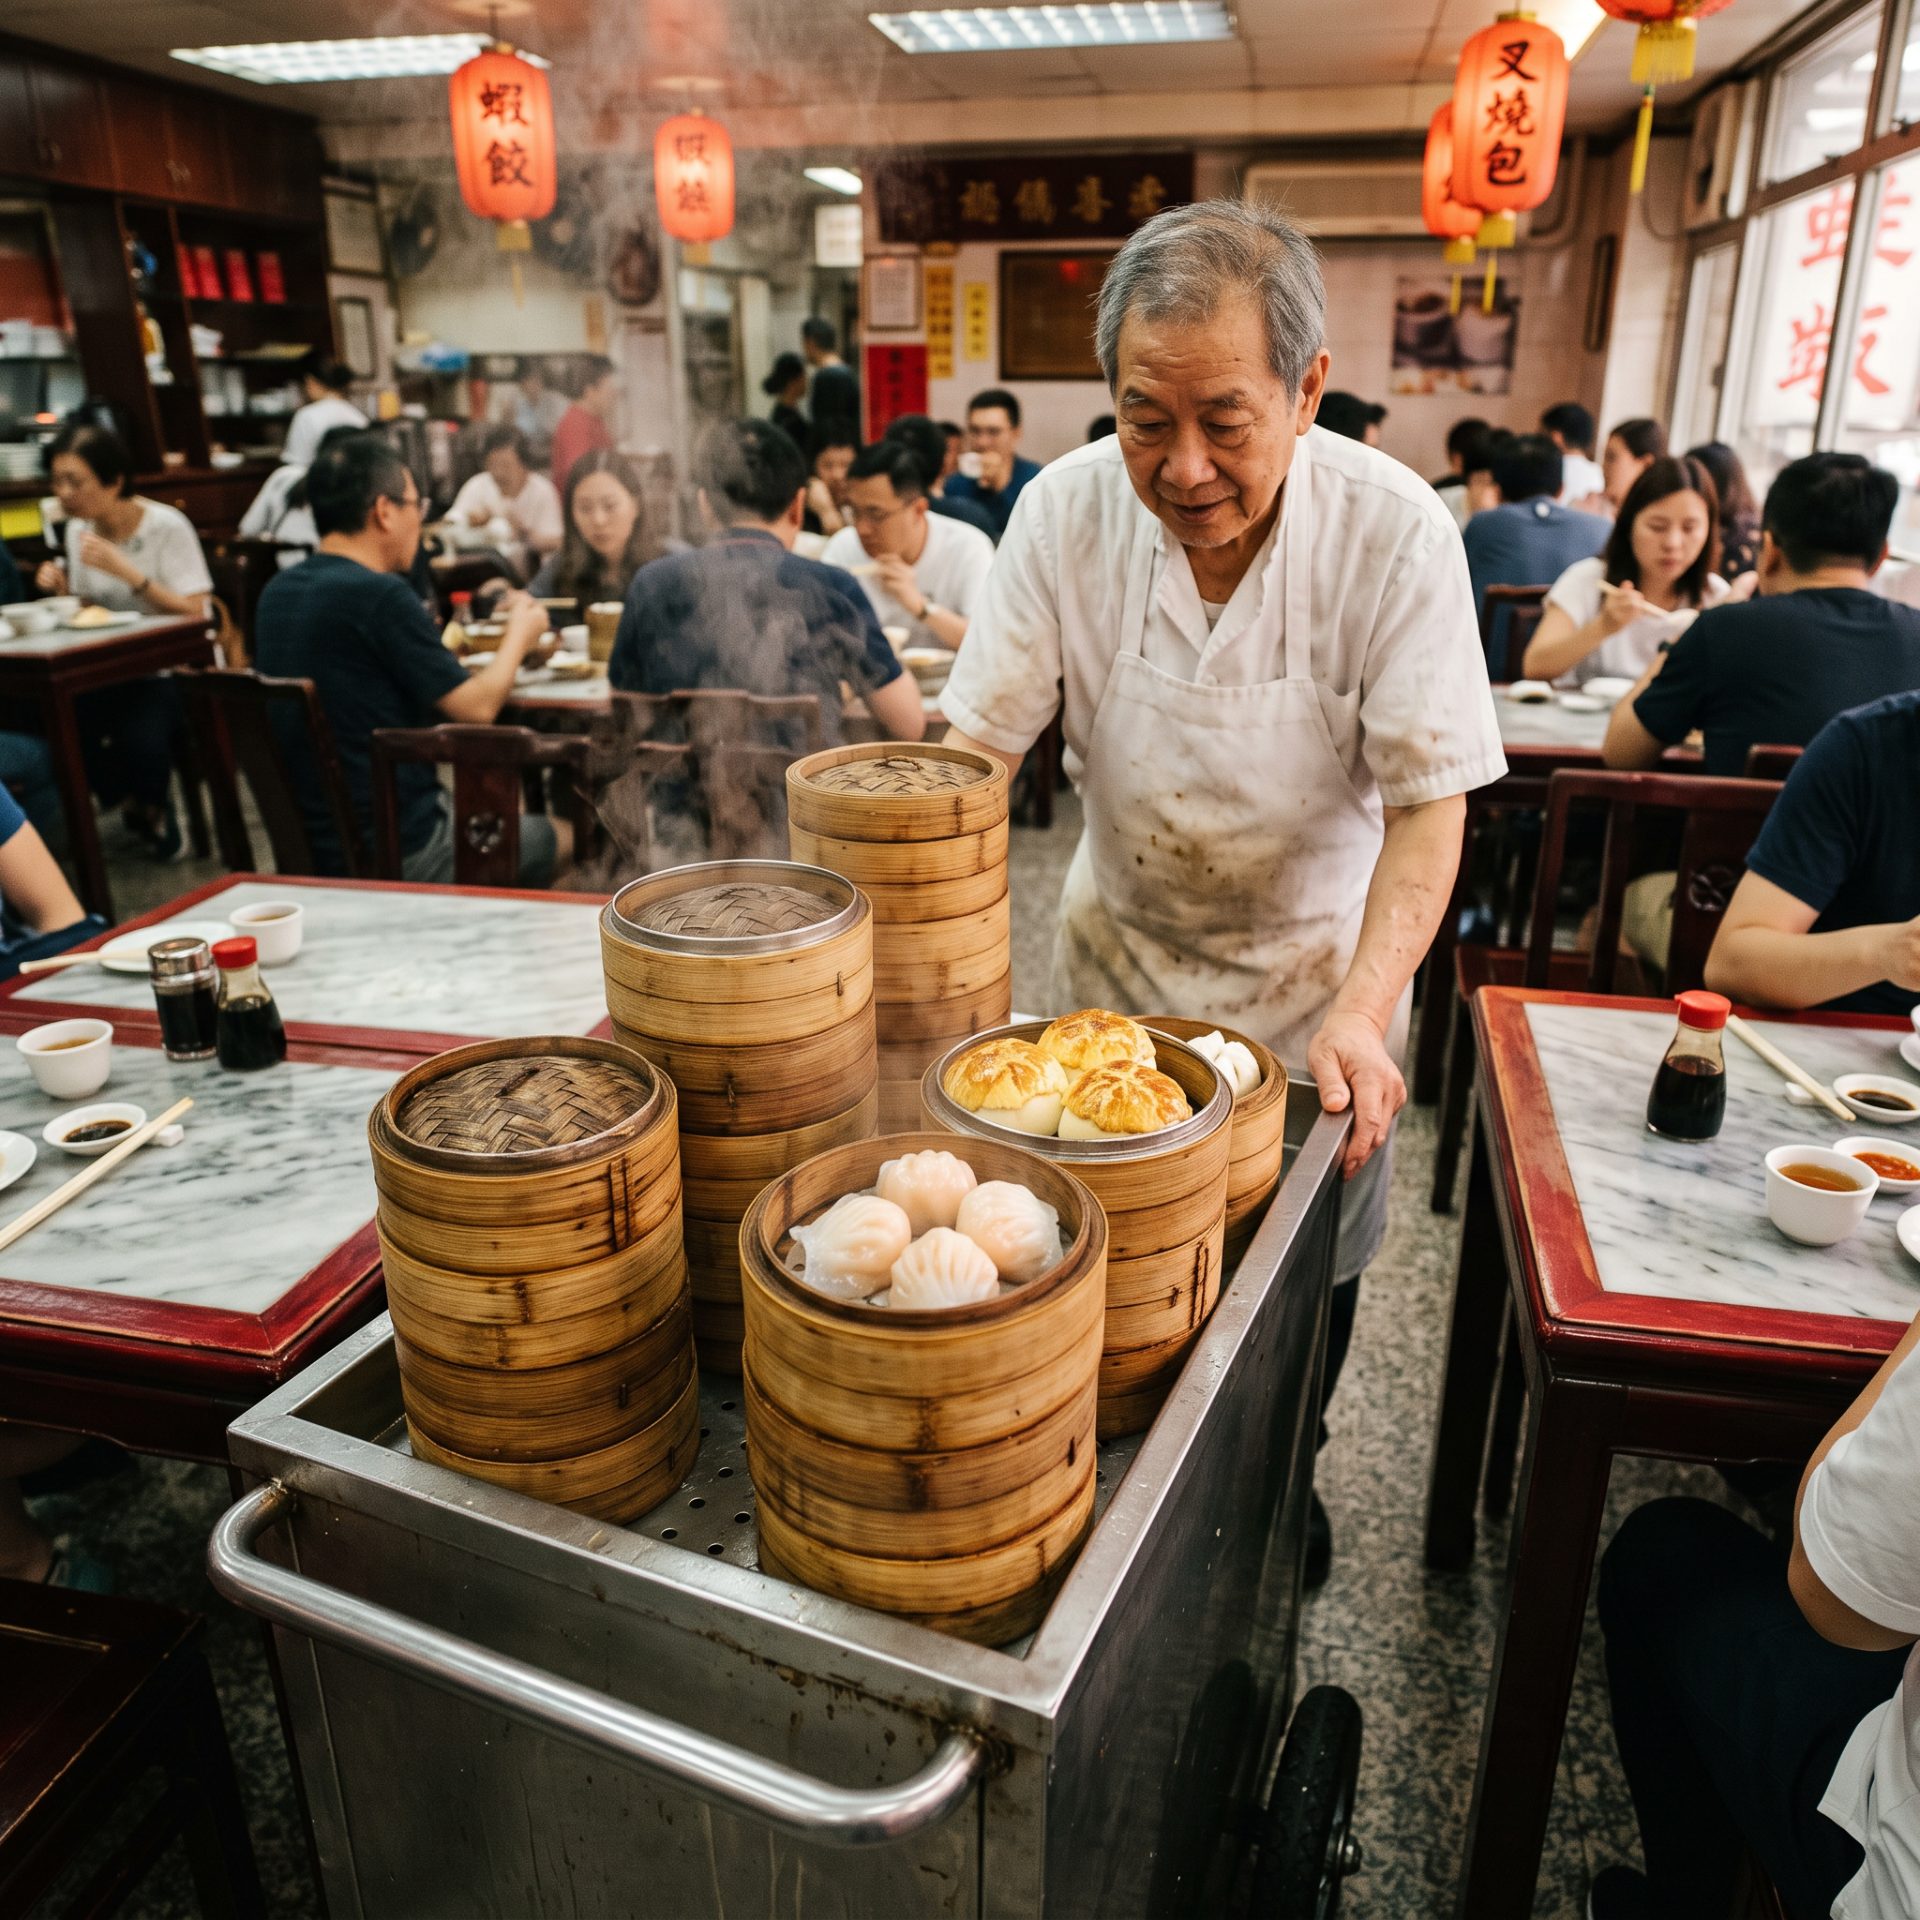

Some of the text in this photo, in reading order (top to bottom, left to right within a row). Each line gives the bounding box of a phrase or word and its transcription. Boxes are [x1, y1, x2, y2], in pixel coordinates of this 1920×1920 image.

[479, 80, 532, 187] 蝦餃
[1484, 40, 1537, 187] 叉燒包
